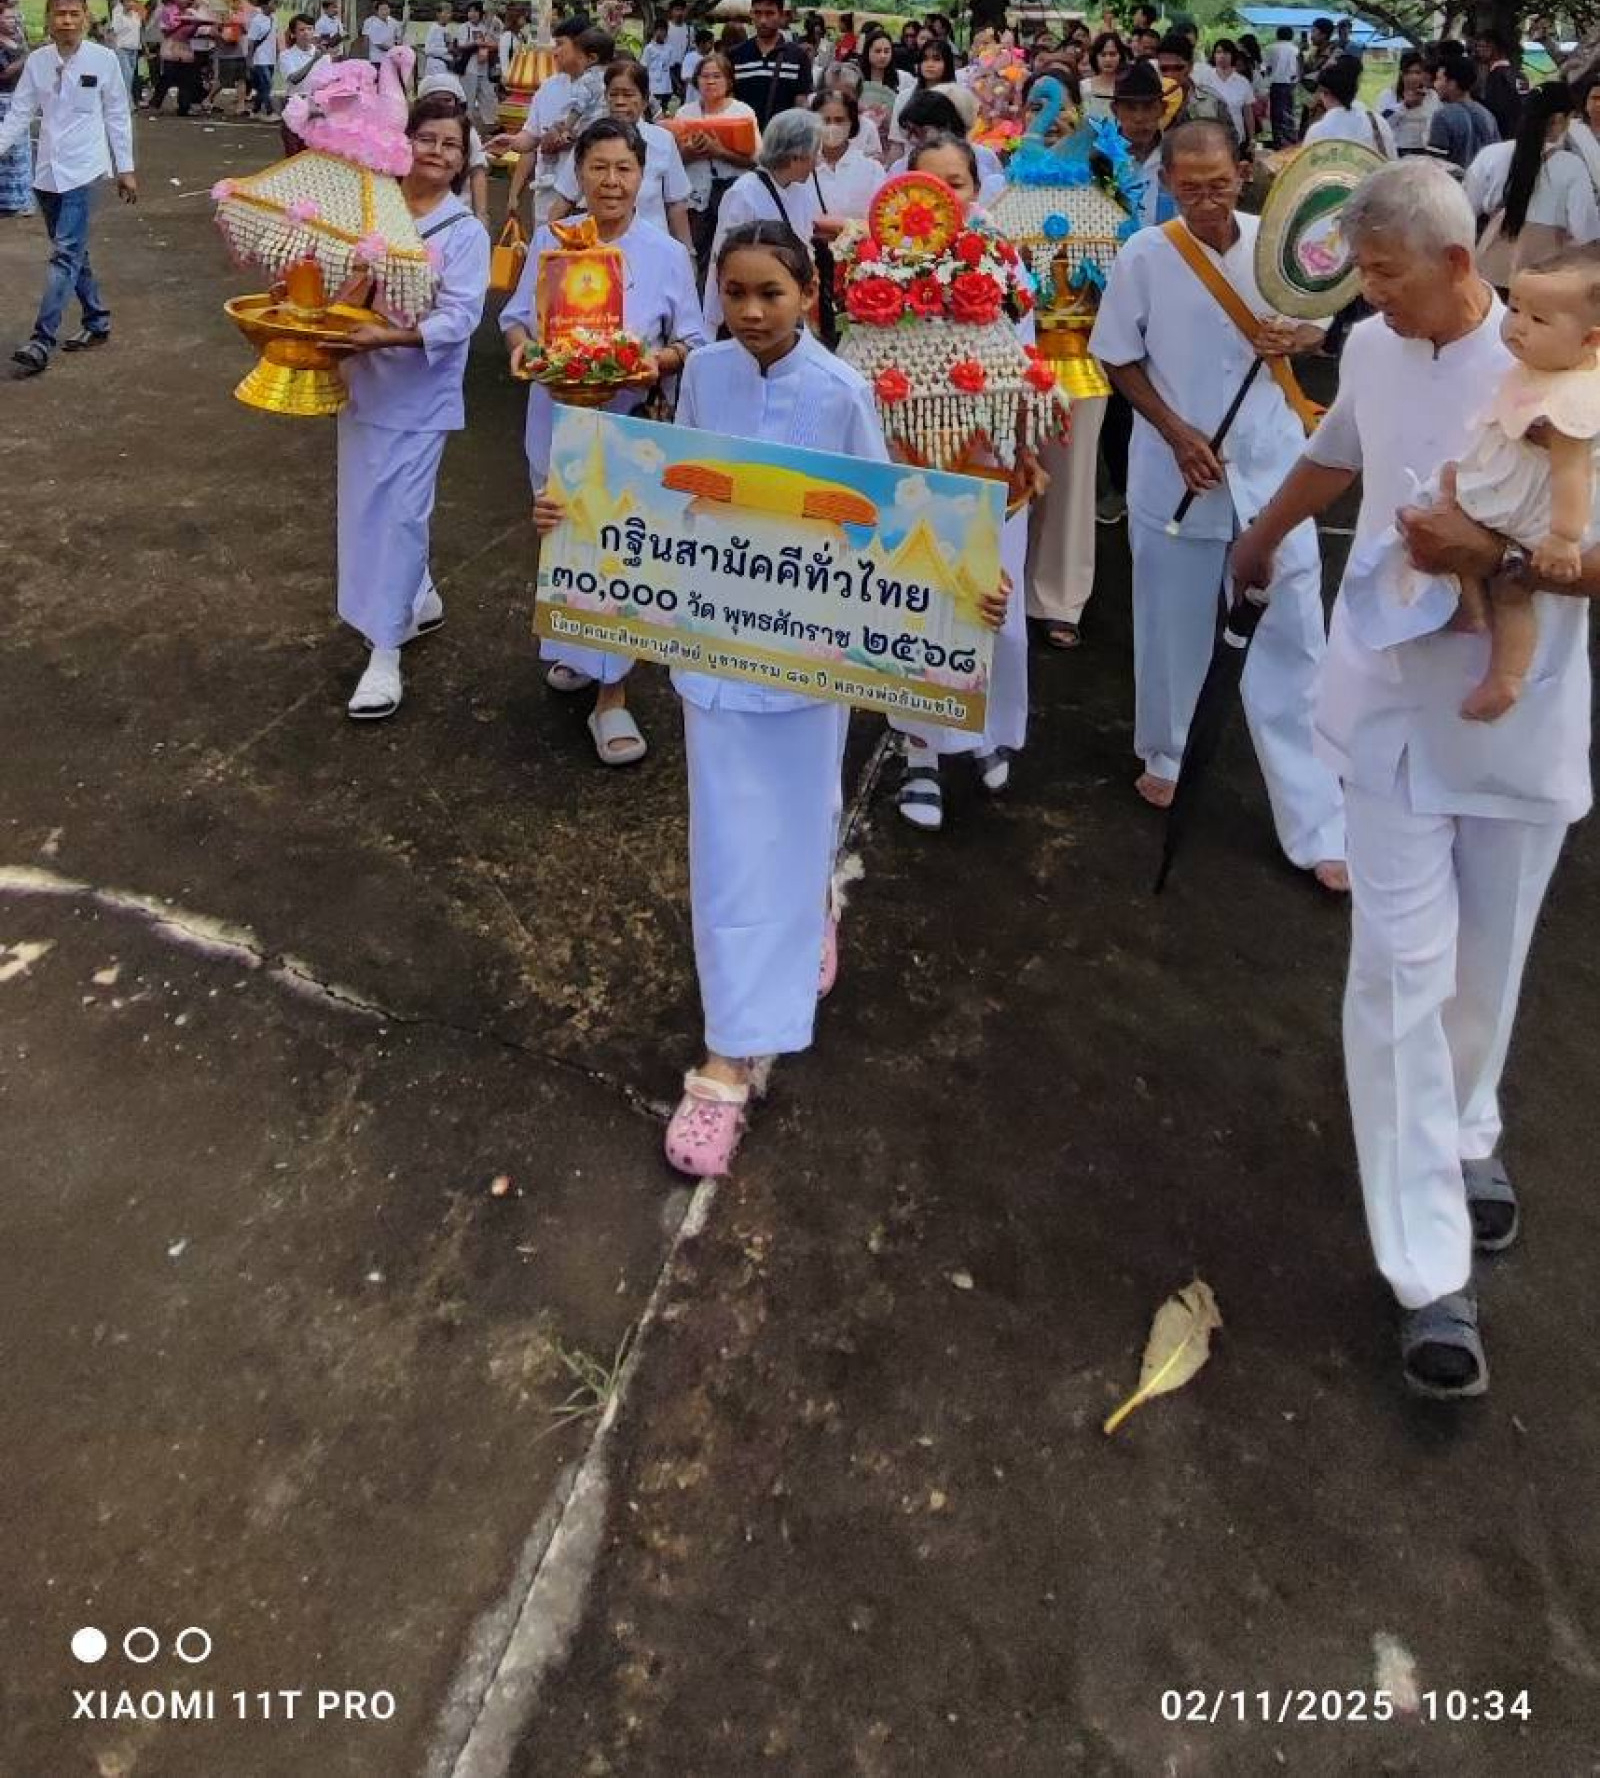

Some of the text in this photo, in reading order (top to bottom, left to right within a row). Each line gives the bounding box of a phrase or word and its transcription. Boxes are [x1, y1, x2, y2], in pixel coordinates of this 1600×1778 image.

[600, 517, 930, 613] กฐินสามัคคีทั่วไทย
[551, 566, 976, 673] ๓๐,๐๐๐ วัด พุทธศักราช ๒๕๖๘
